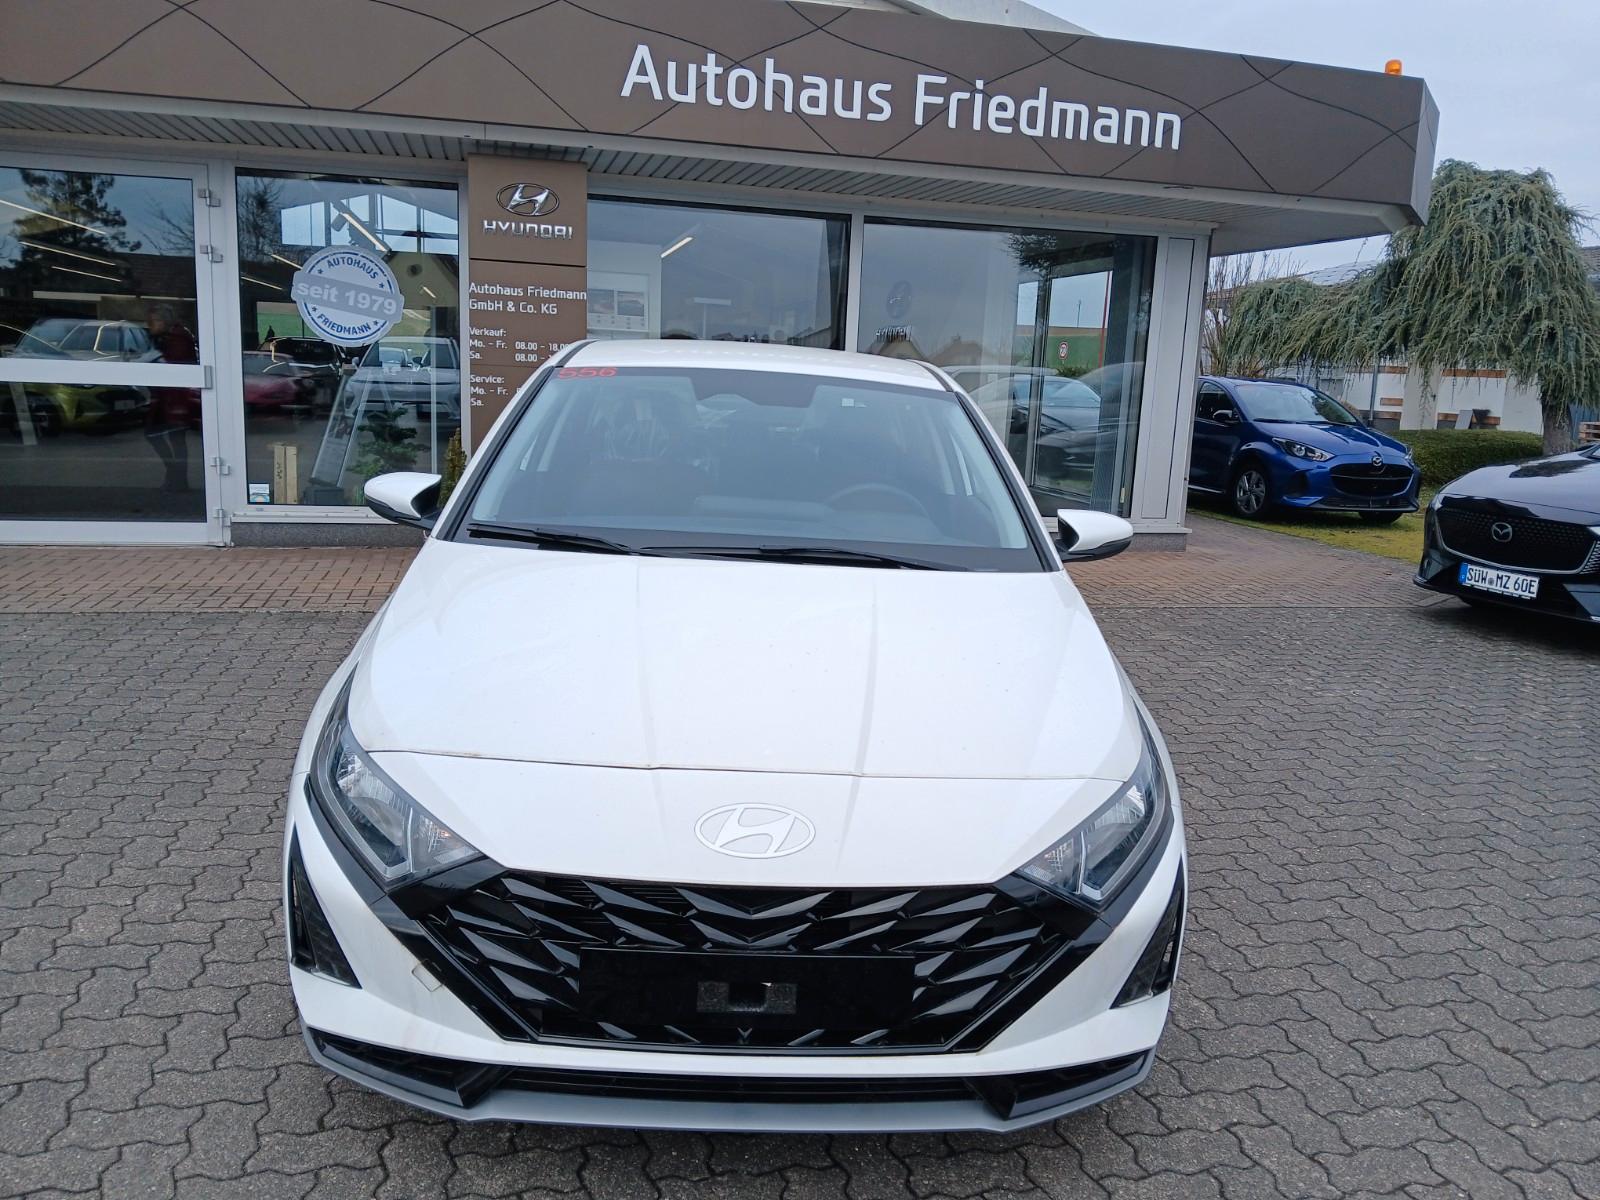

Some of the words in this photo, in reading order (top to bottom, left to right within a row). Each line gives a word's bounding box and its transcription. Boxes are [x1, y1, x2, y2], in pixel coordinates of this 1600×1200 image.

[620, 44, 892, 122] Autohaus
[914, 73, 1182, 150] Friedmann
[483, 219, 573, 240] HYUNDAI
[327, 256, 379, 279] AUTOHAUS
[297, 282, 338, 302] seit
[345, 290, 397, 315] 1979
[469, 282, 524, 297] Autohaus
[527, 285, 587, 300] Friedmann
[469, 299, 503, 311] GmbH
[507, 301, 515, 312] &
[519, 302, 537, 313] Co.
[541, 303, 558, 315] KG
[317, 313, 371, 336] FRIEDMANN
[469, 327, 507, 337] Verkauf:
[469, 339, 486, 348] Mo.
[496, 340, 508, 349] Fr.
[515, 341, 538, 351] 08.00
[469, 351, 482, 359] Sa.
[515, 353, 538, 362] 08.00
[470, 374, 505, 384] Service:
[470, 386, 487, 395] Mo.
[497, 387, 509, 396] Fr.
[470, 397, 484, 406] Sa.
[1467, 567, 1488, 585] SÜW
[1495, 573, 1511, 590] MZ
[1513, 577, 1537, 595] 60E
